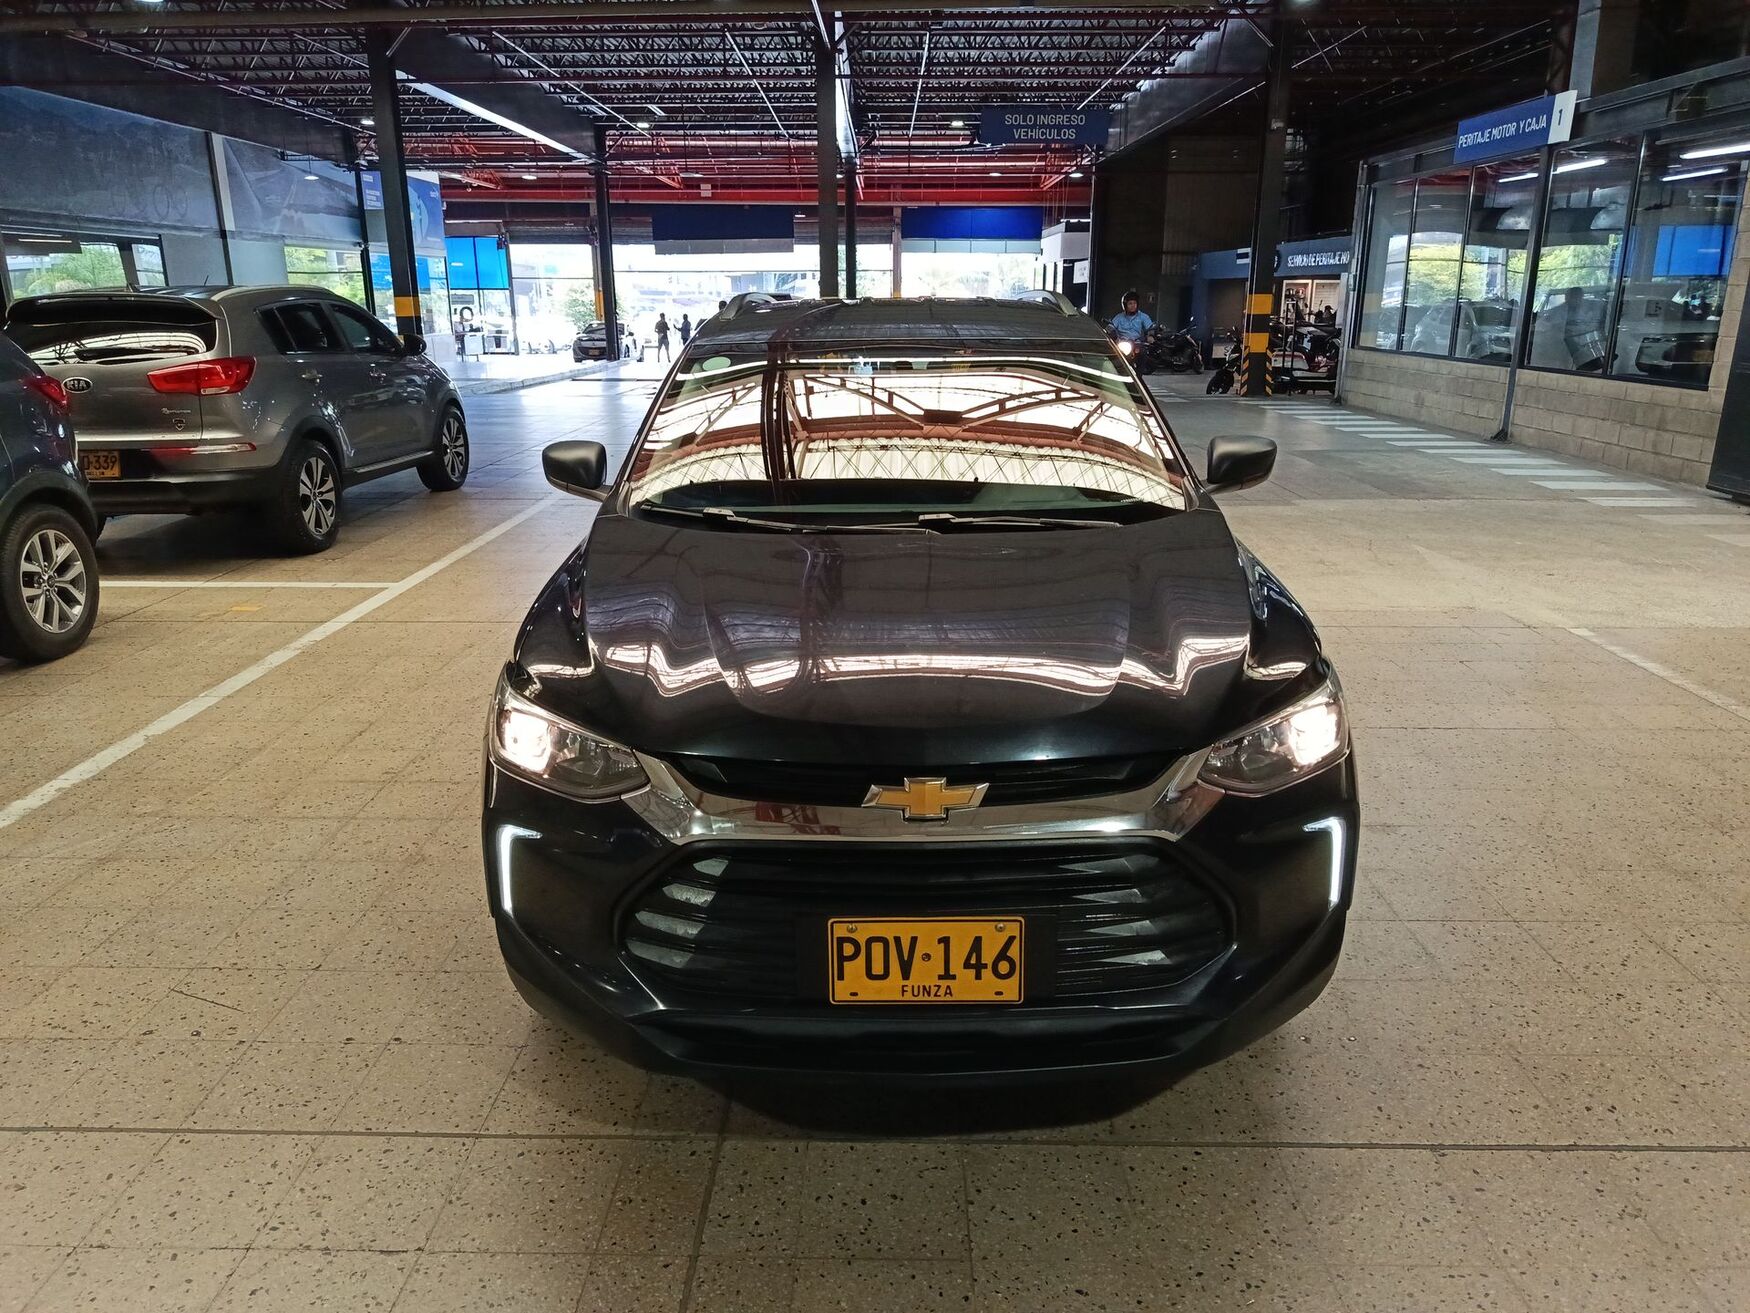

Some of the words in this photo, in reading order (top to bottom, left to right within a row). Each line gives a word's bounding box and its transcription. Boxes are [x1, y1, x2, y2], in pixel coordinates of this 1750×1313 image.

[1004, 114, 1034, 125] SOLO
[1037, 114, 1086, 125] INGRESO
[1558, 108, 1564, 126] 1
[1013, 126, 1076, 139] VEHÍCULOS
[1458, 128, 1491, 148] PERITAJE
[1491, 122, 1516, 140] MOTOR
[1519, 119, 1526, 133] Y
[1525, 114, 1547, 132] CAJA
[901, 984, 953, 998] FUNZA
